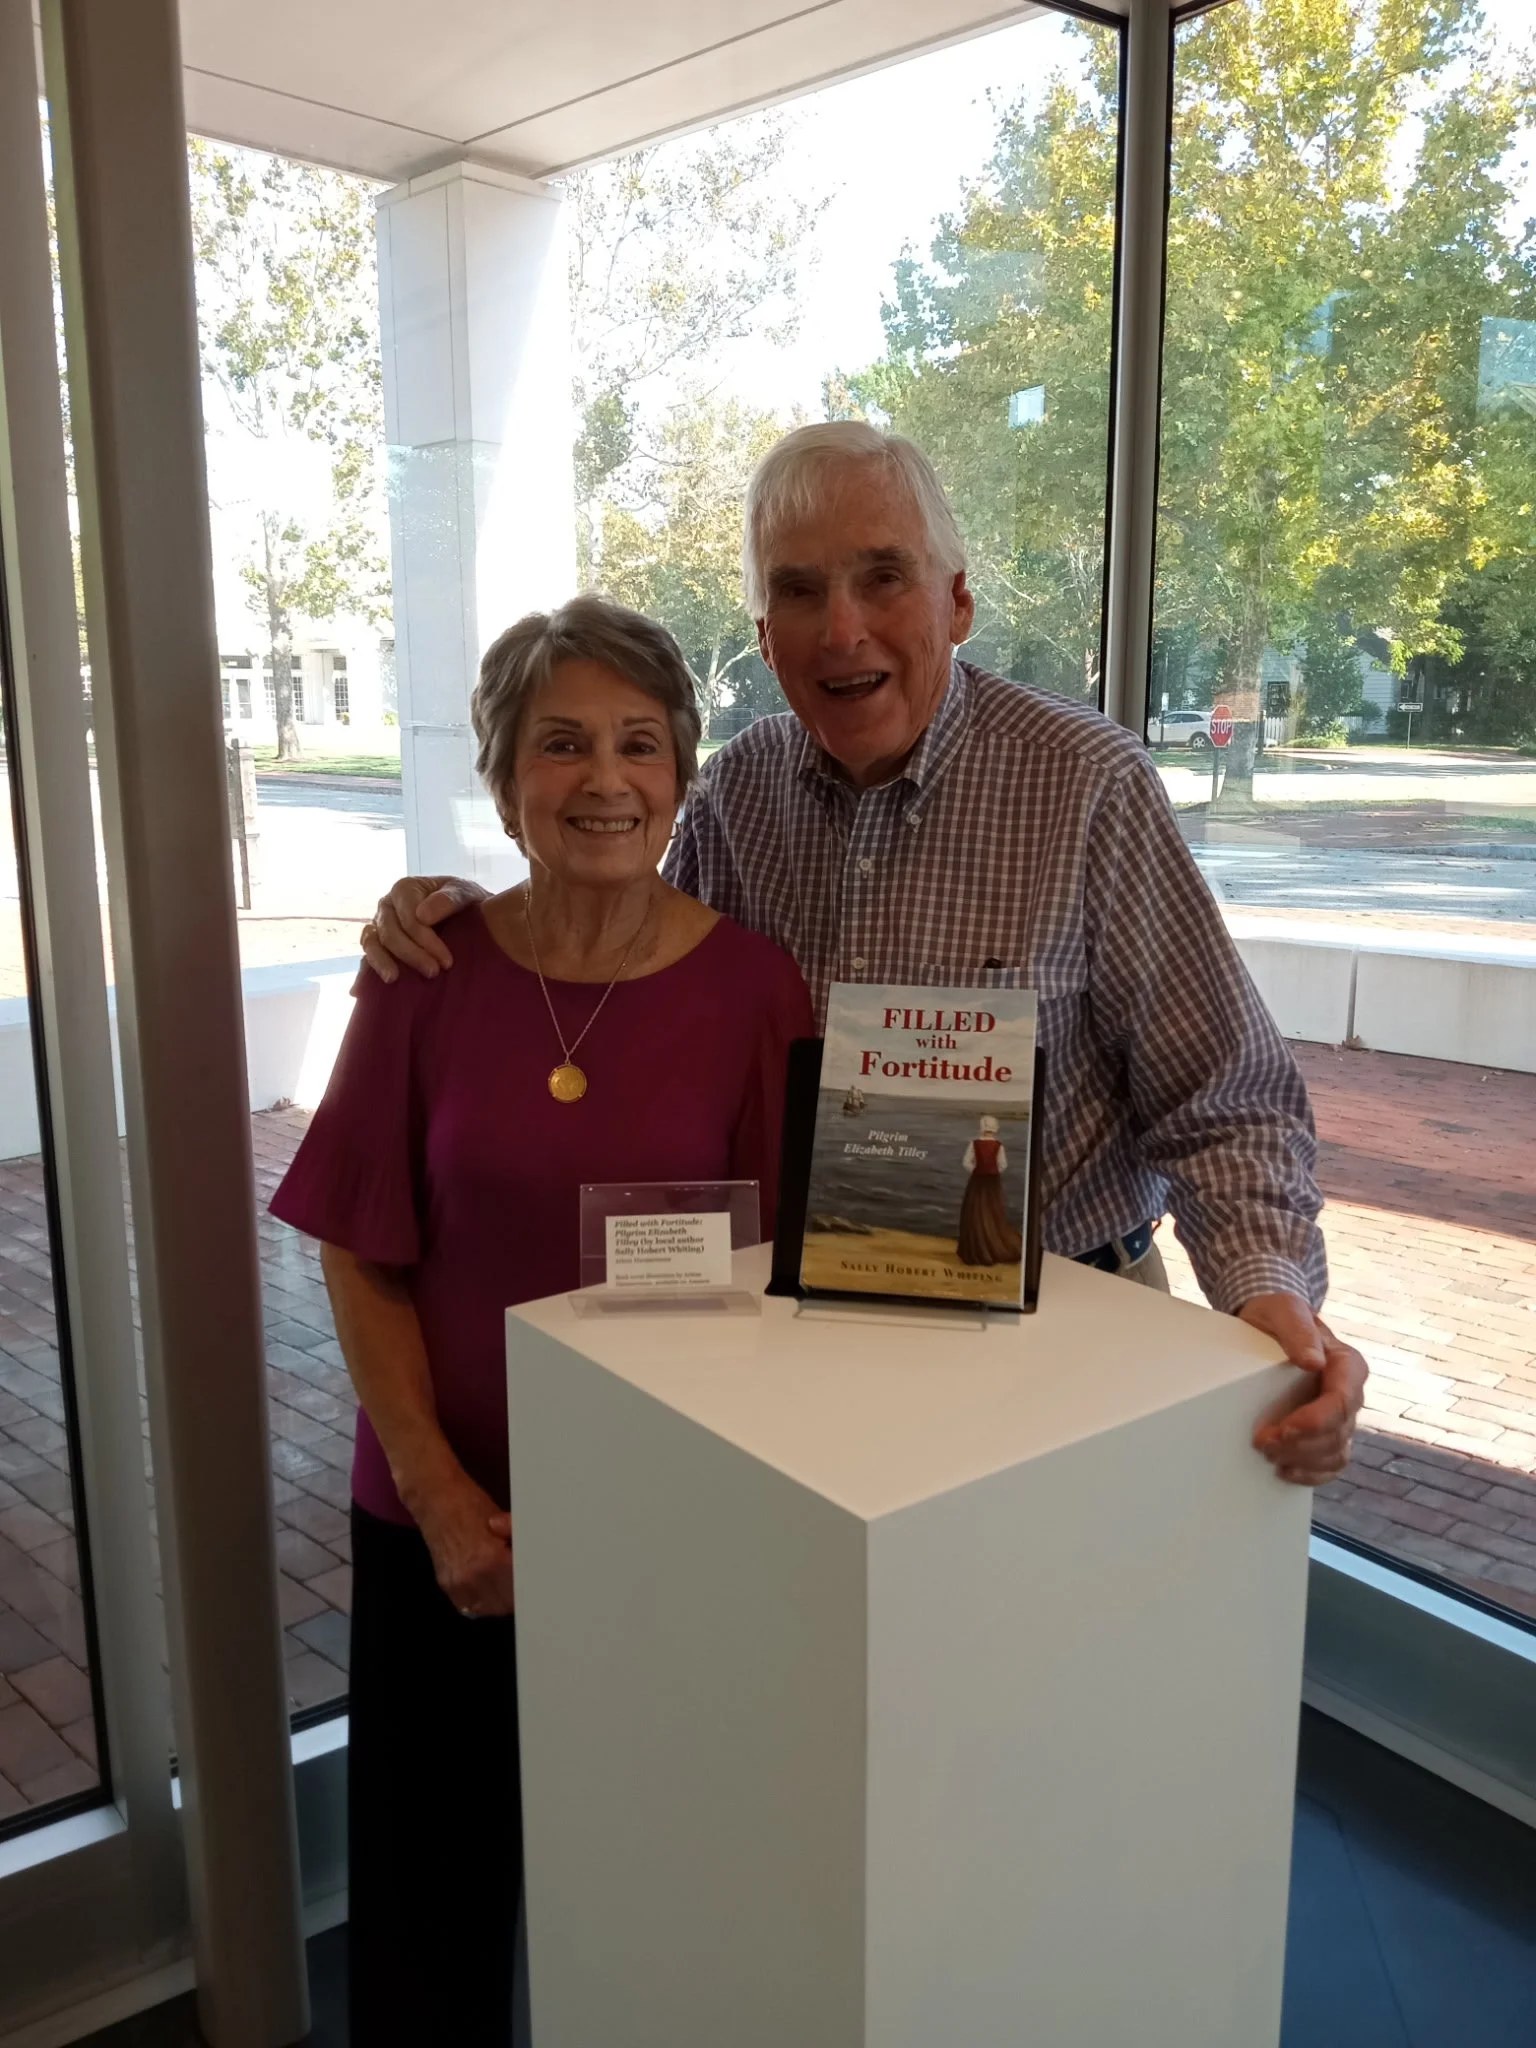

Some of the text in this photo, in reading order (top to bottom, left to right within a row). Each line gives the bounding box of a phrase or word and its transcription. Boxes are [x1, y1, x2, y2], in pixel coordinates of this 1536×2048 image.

[1211, 719, 1232, 734] STOP
[882, 1008, 996, 1033] FILLED
[916, 1034, 957, 1049] with
[859, 1050, 1012, 1083] Fortitude
[868, 1129, 908, 1142] Pilgrim
[844, 1143, 928, 1160] Elizabeth Tilley
[615, 1219, 638, 1228] Filled
[640, 1219, 659, 1227] with
[615, 1228, 687, 1238] Pilgrim Elizabeth
[616, 1236, 704, 1246] Tilley (by local author
[615, 1247, 634, 1256] Sally
